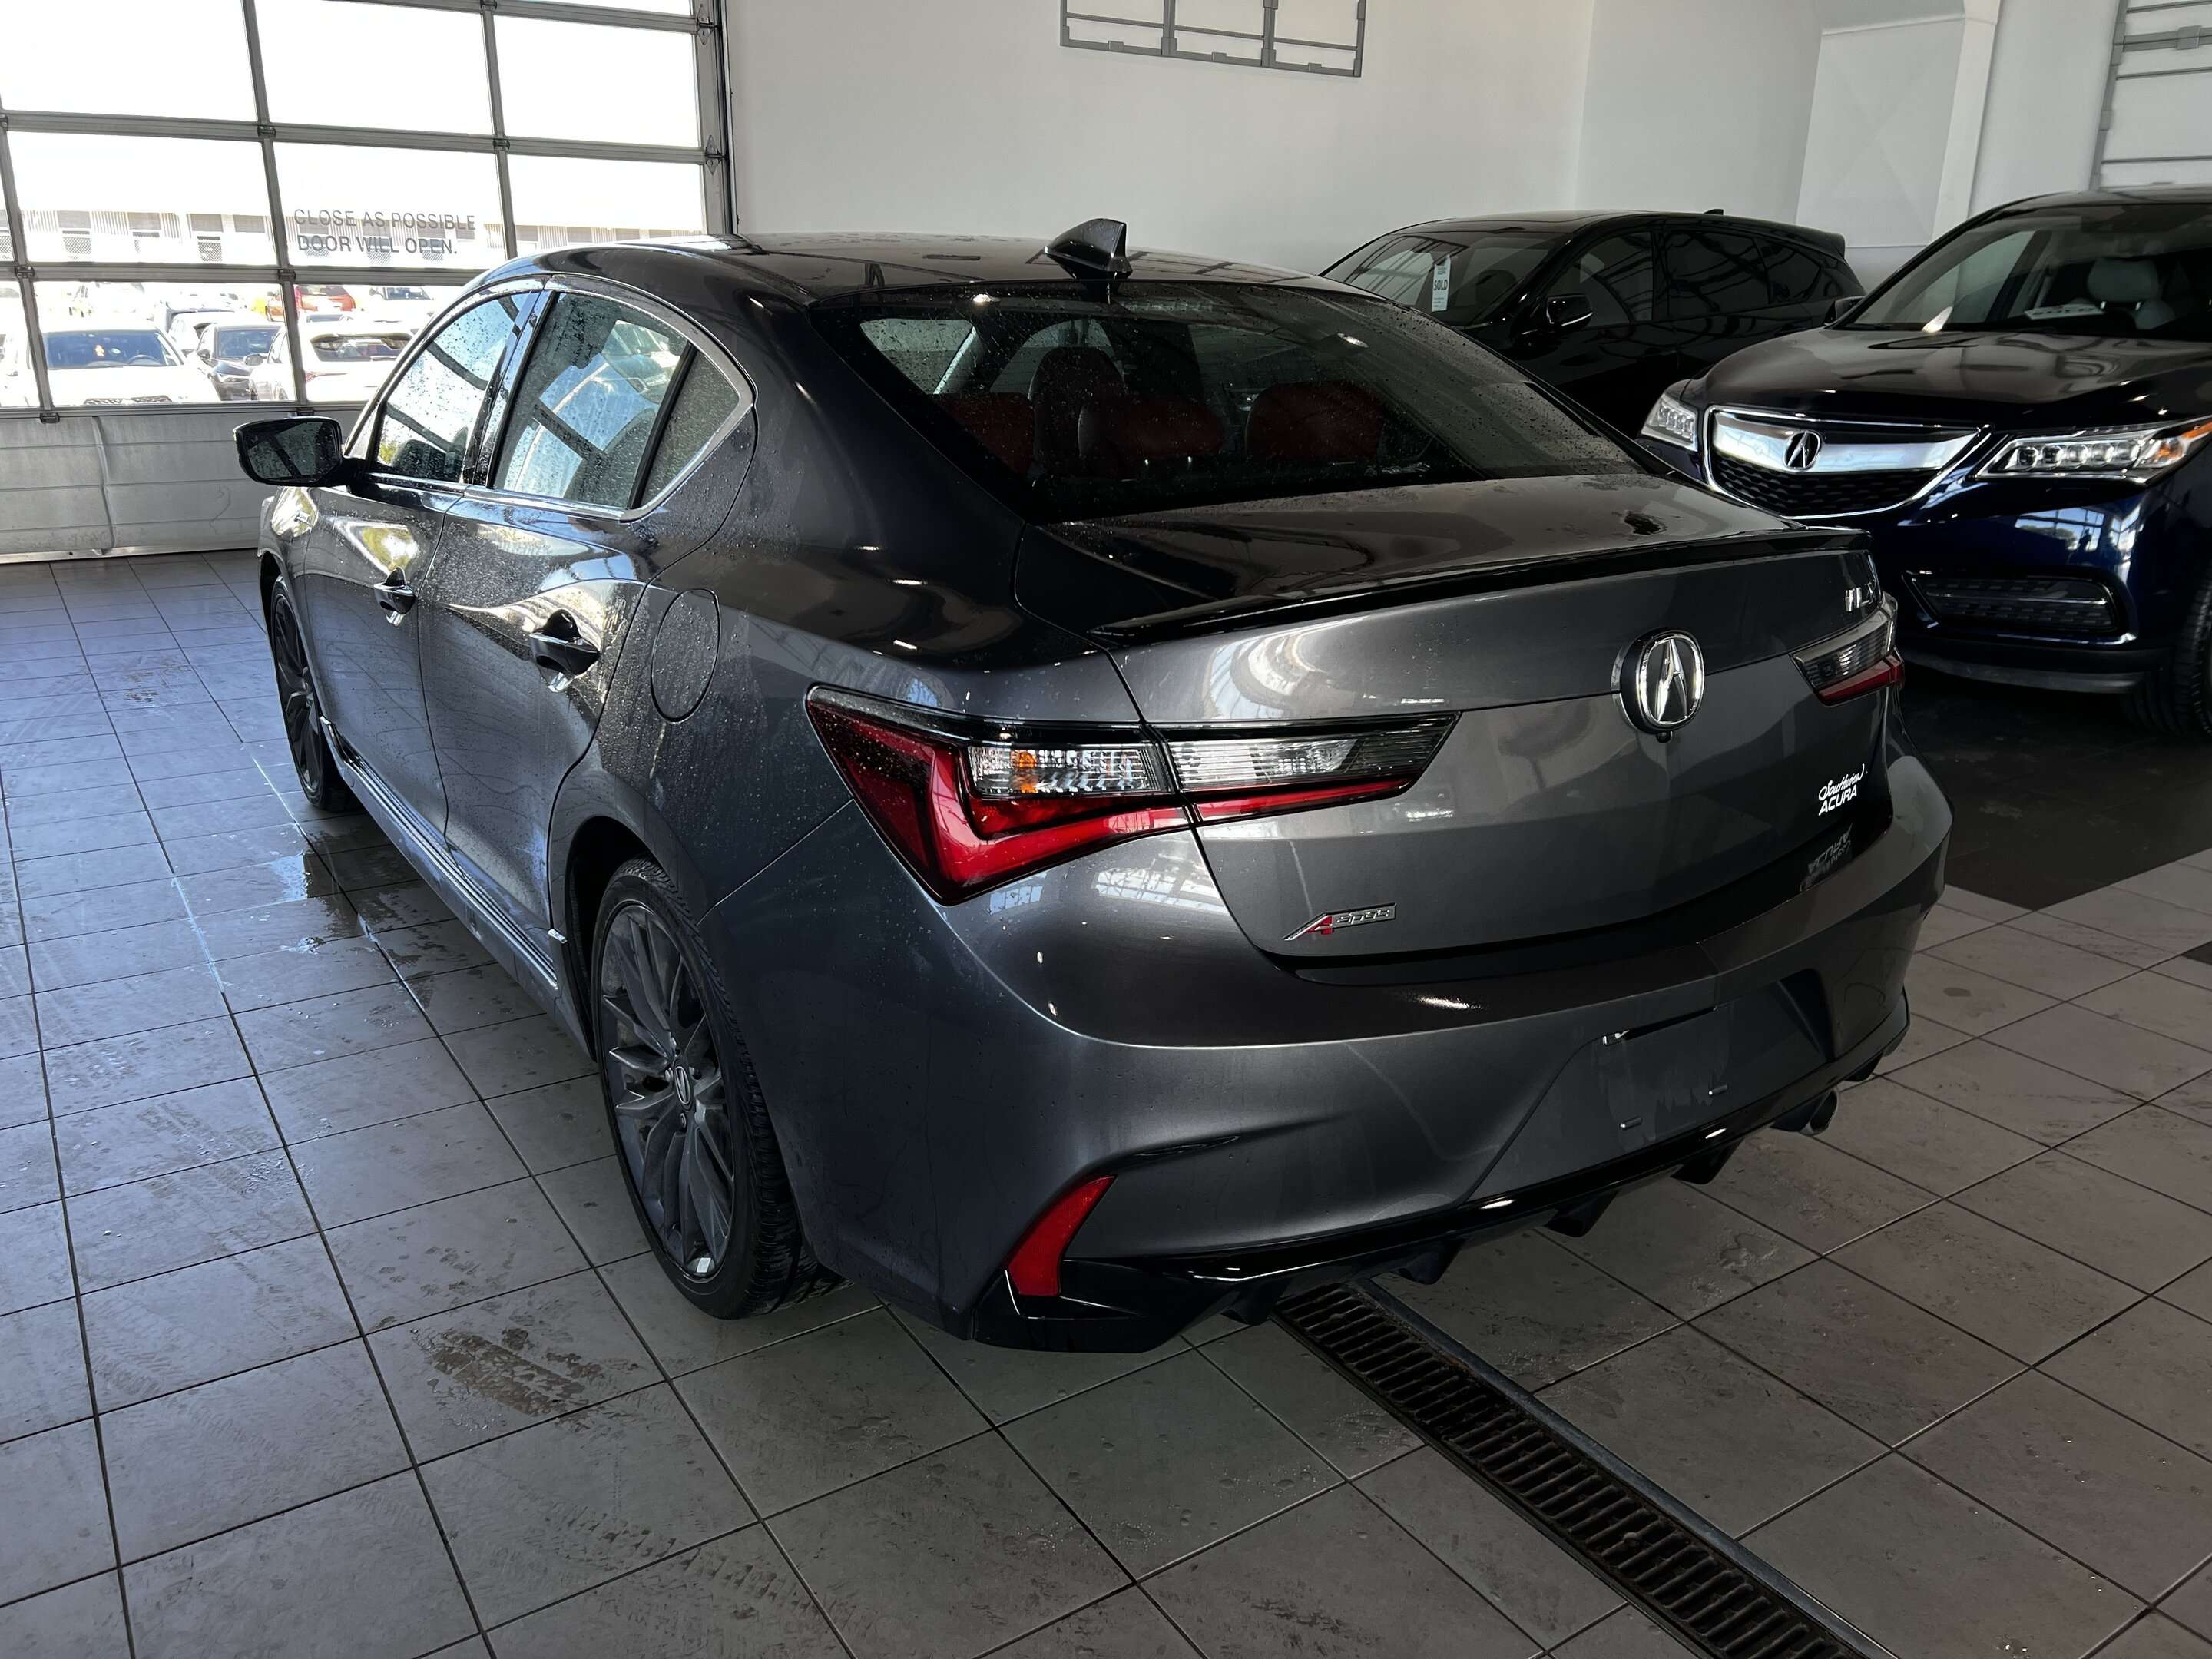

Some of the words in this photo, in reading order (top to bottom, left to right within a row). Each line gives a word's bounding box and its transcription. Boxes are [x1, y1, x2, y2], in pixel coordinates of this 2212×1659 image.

[294, 209, 356, 227] CLOSE
[362, 213, 386, 227] AS
[392, 212, 475, 230] POSSIBLE
[297, 236, 351, 252] DOOR
[356, 237, 399, 253] WILL
[405, 239, 457, 254] OPEN.
[1434, 279, 1449, 291] SOLD
[1818, 783, 1858, 816] ACURA
